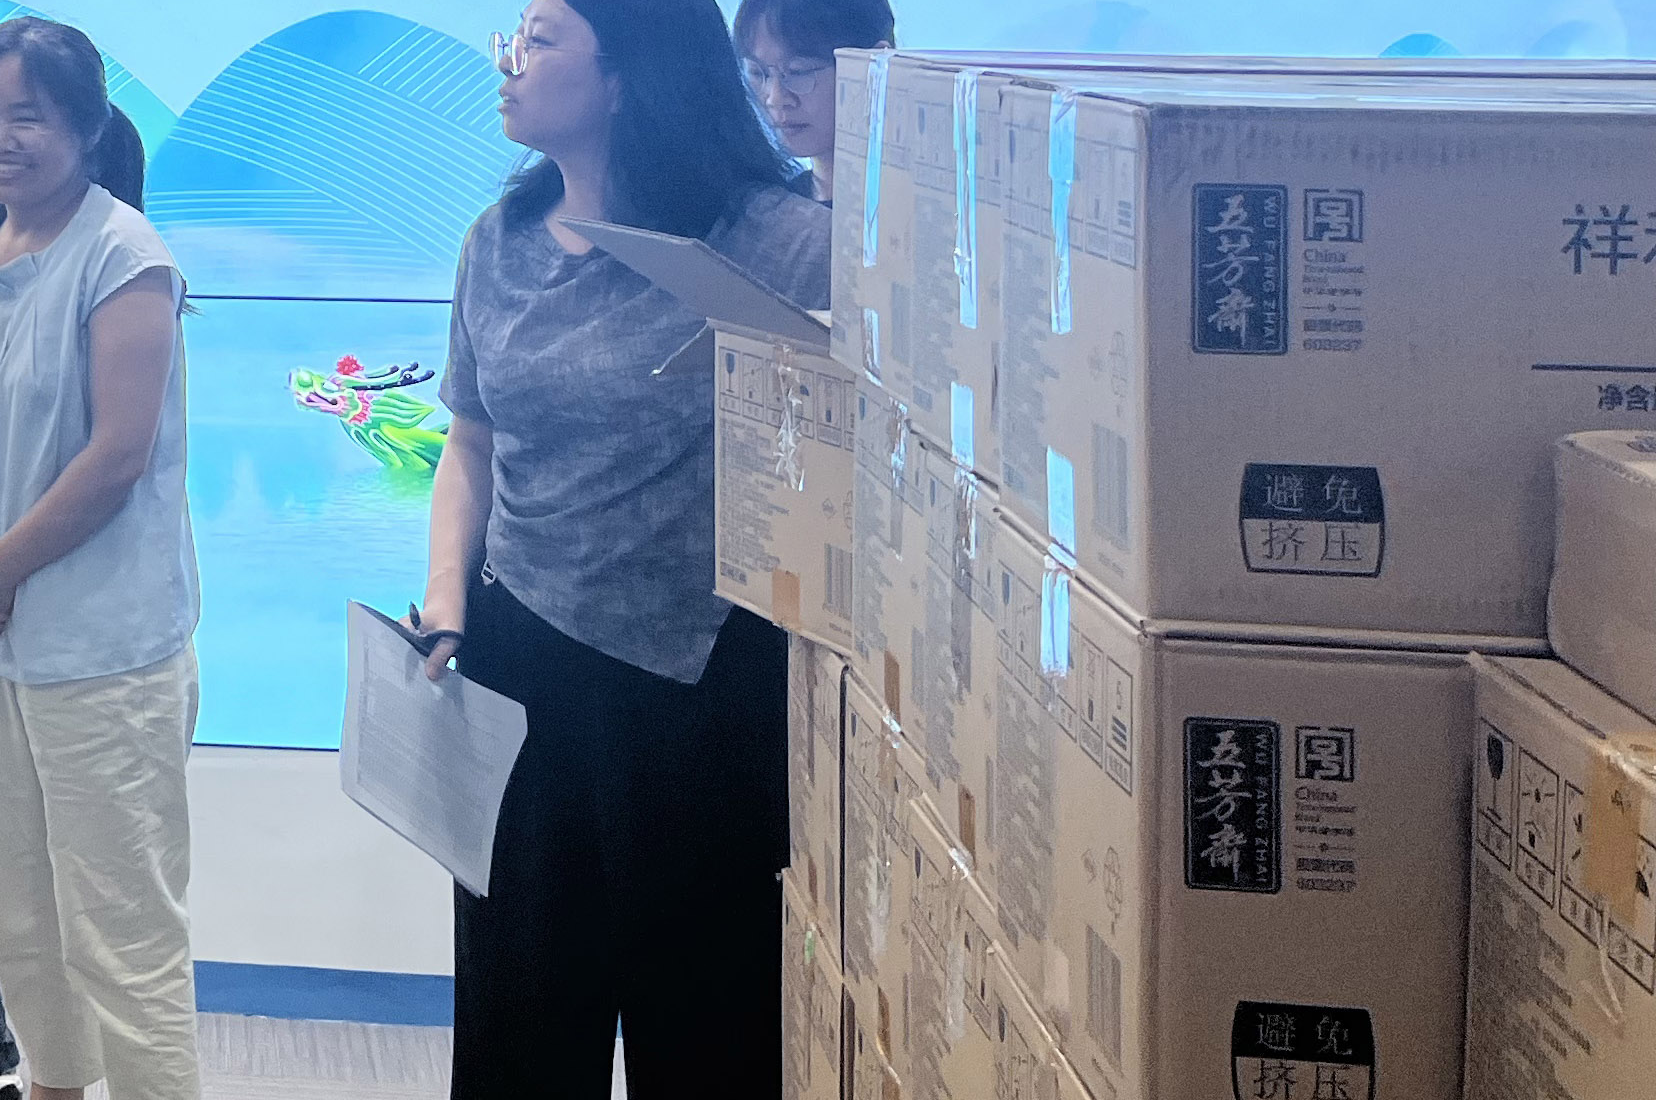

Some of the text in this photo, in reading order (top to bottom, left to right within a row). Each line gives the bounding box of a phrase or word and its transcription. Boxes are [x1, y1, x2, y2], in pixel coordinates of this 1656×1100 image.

[1302, 248, 1347, 263] China
[1597, 384, 1656, 412] 净含
[1262, 473, 1364, 514] 避免
[1260, 521, 1363, 562] 挤压
[1256, 1012, 1353, 1055] 避免
